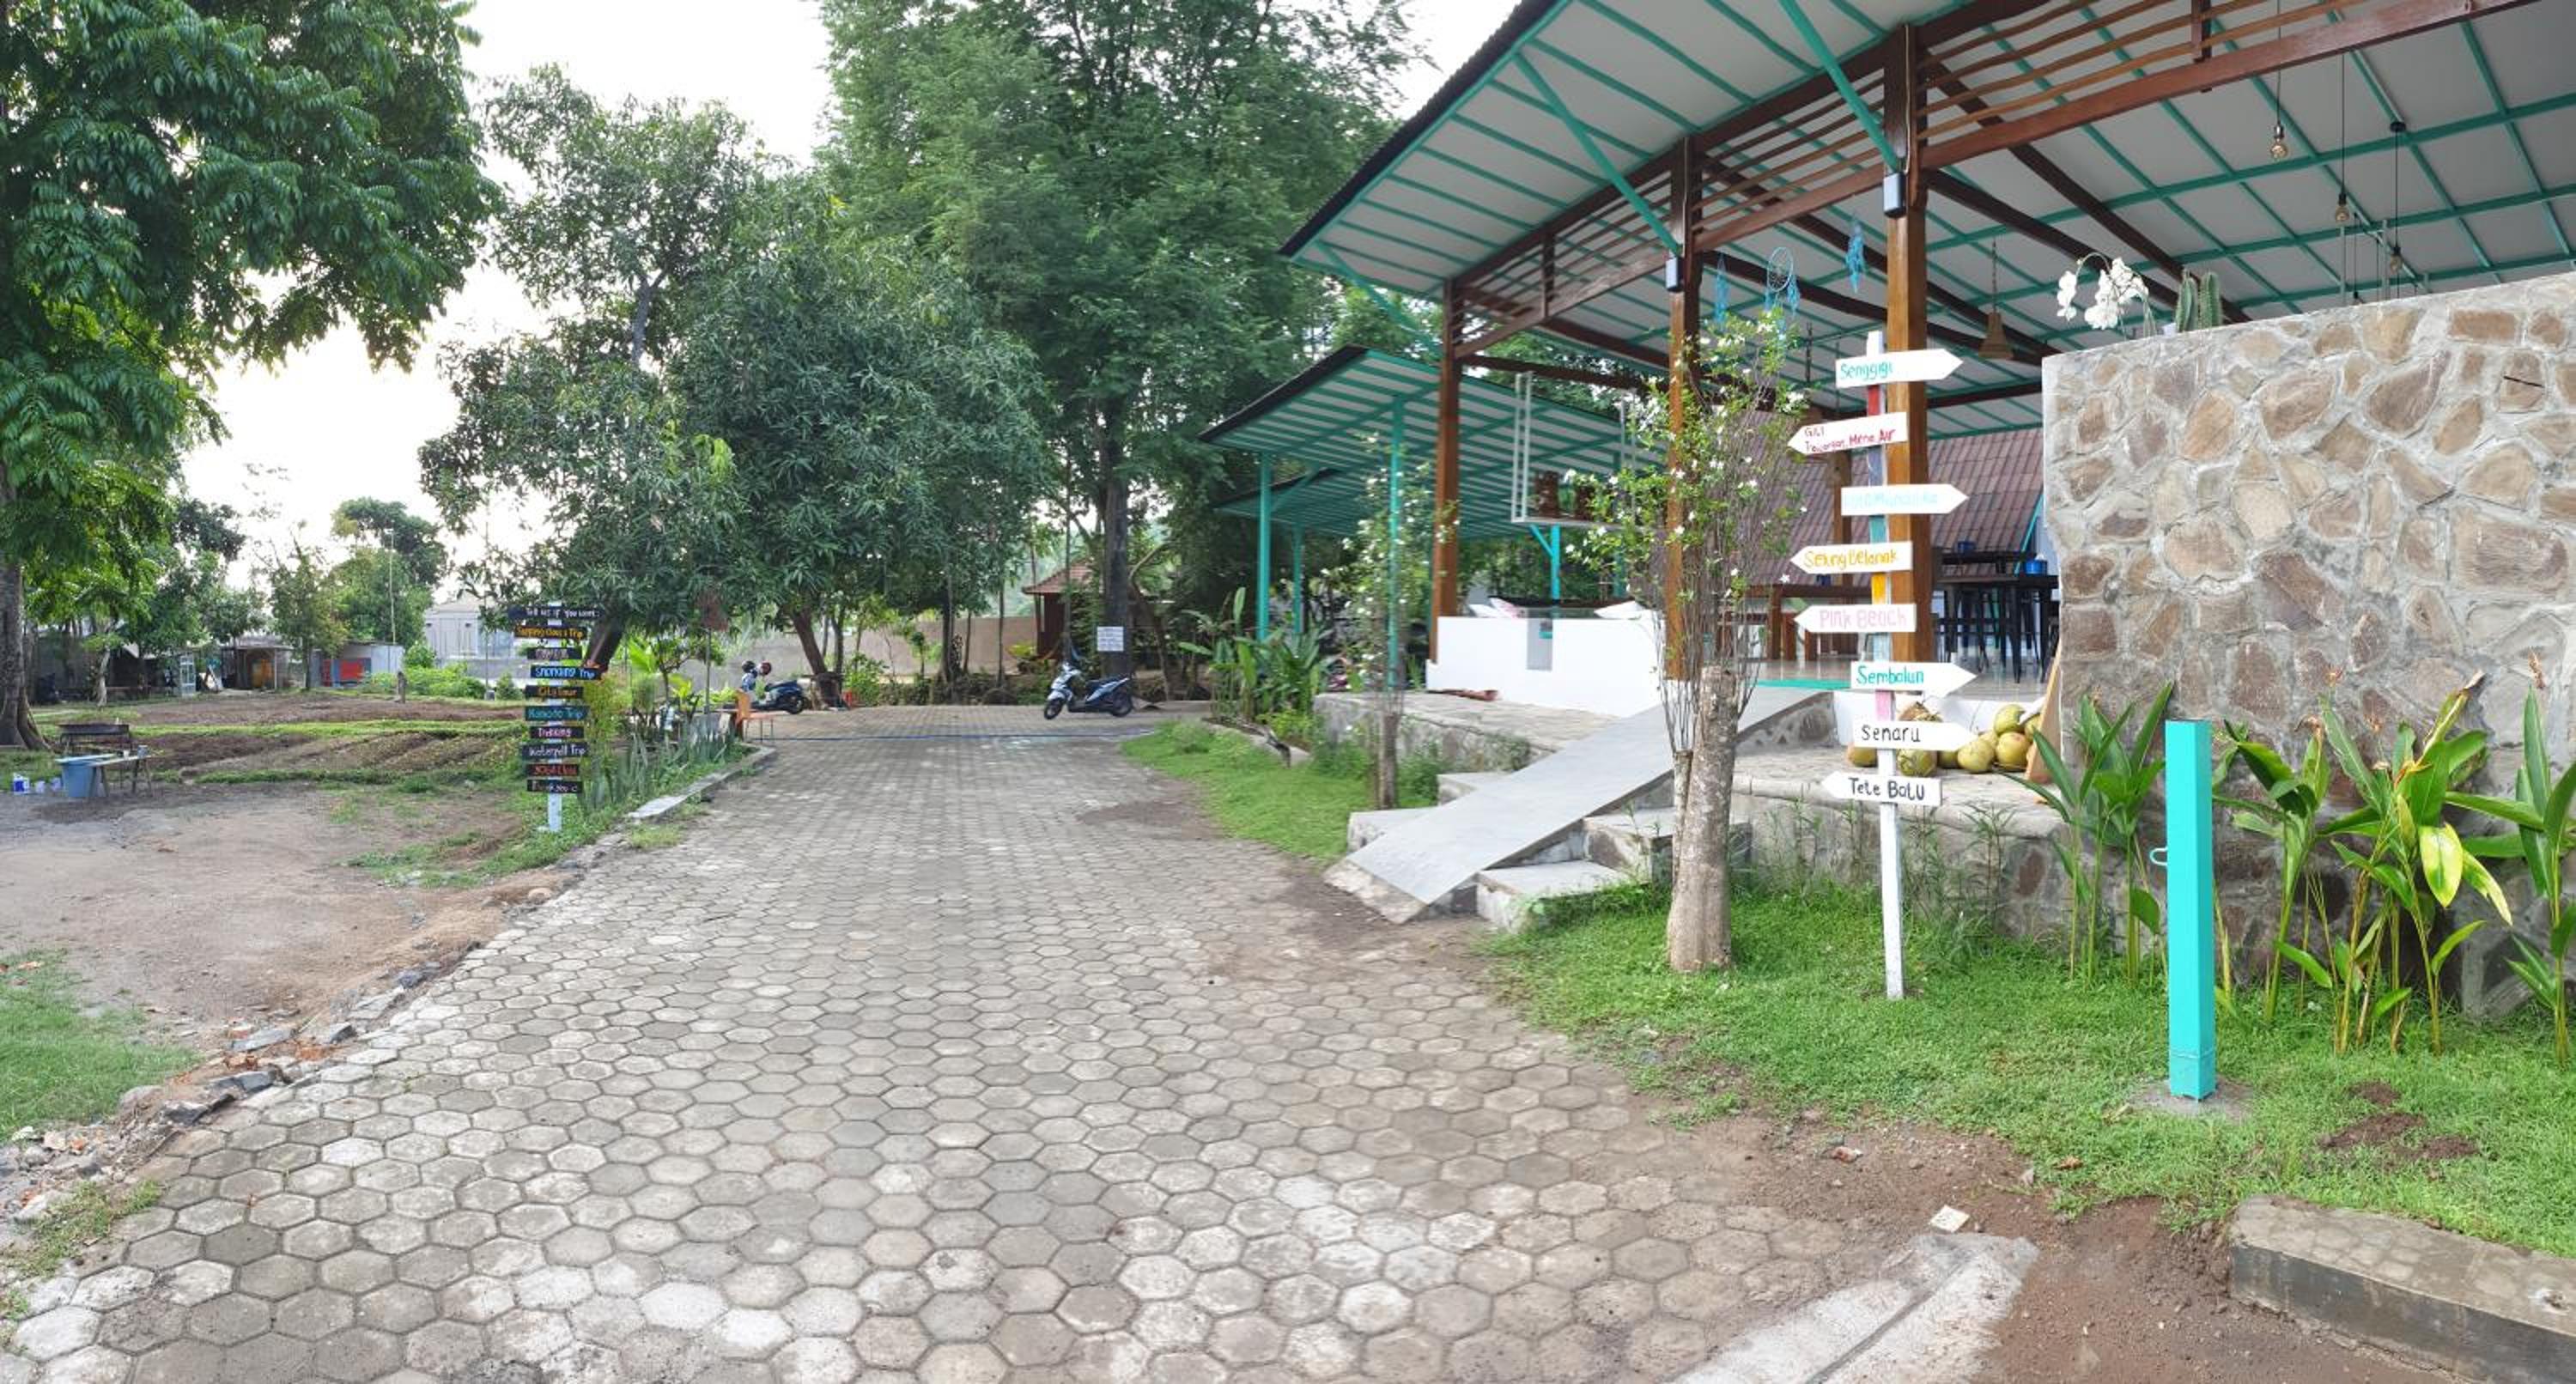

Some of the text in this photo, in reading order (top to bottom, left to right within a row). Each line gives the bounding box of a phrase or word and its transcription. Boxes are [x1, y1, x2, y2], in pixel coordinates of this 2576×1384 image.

[1840, 361, 1893, 380] Senggigi
[1856, 608, 1907, 629] Beach
[1856, 664, 1924, 685] Sembalun
[1861, 724, 1921, 743] Senaru
[1848, 777, 1880, 796] Tete
